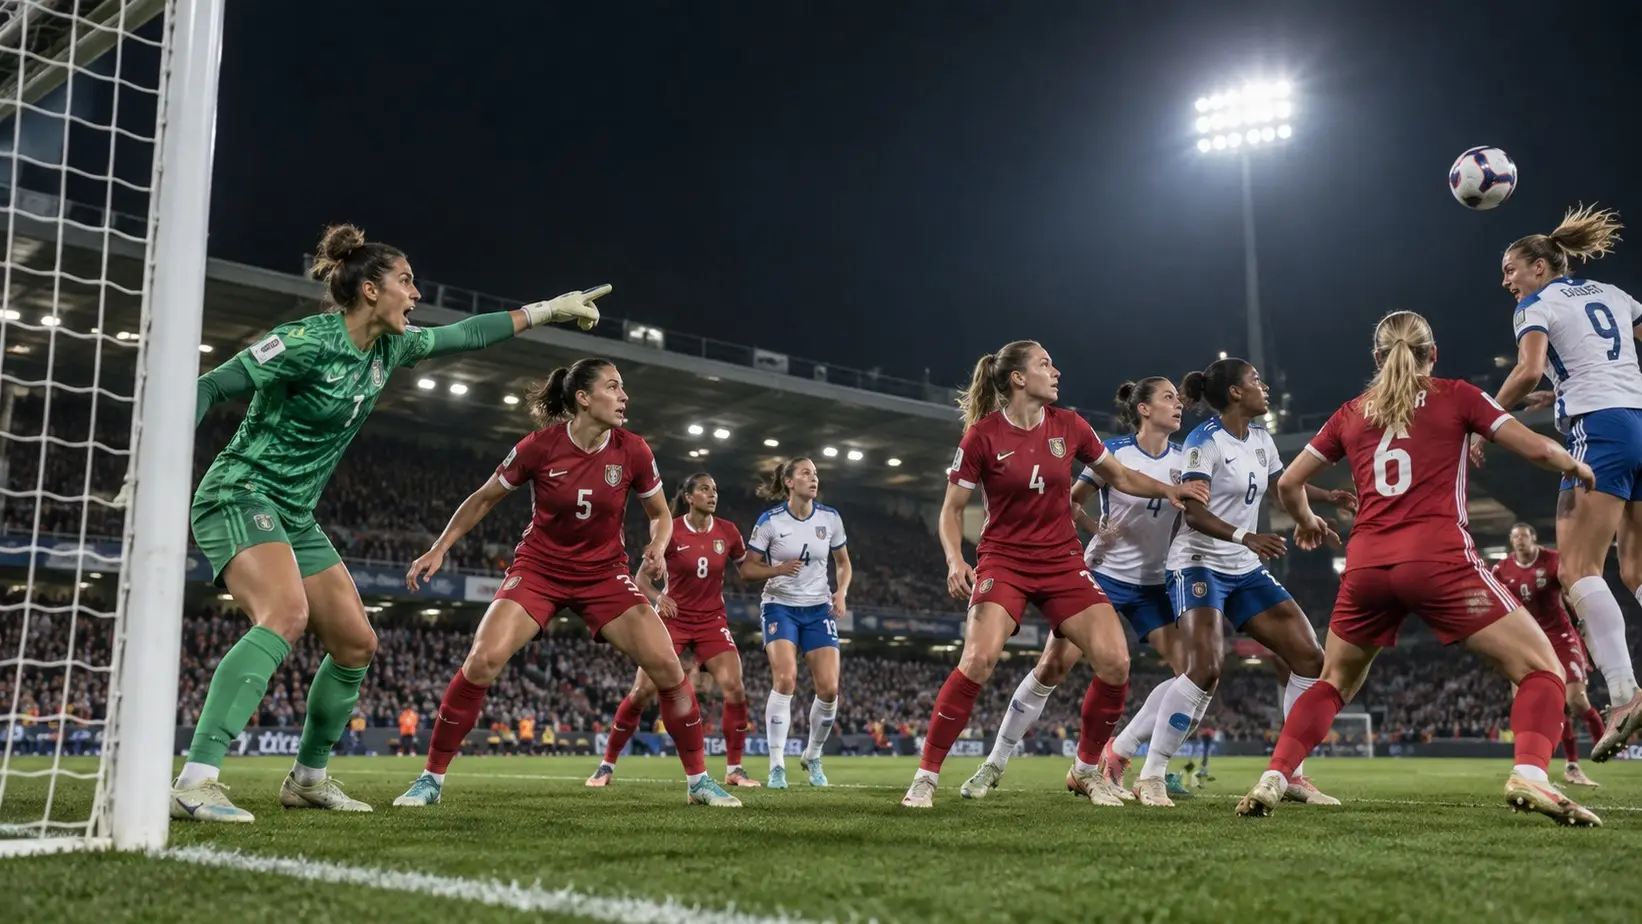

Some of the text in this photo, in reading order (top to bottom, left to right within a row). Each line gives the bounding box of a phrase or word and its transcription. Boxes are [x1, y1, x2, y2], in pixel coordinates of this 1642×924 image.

[1584, 301, 1621, 361] 9
[344, 394, 365, 428] 7
[1374, 423, 1412, 497] 6
[1029, 464, 1045, 494] 4
[1245, 471, 1257, 505] 6
[575, 489, 593, 520] 5
[696, 557, 709, 578] 8
[799, 543, 811, 566] 4
